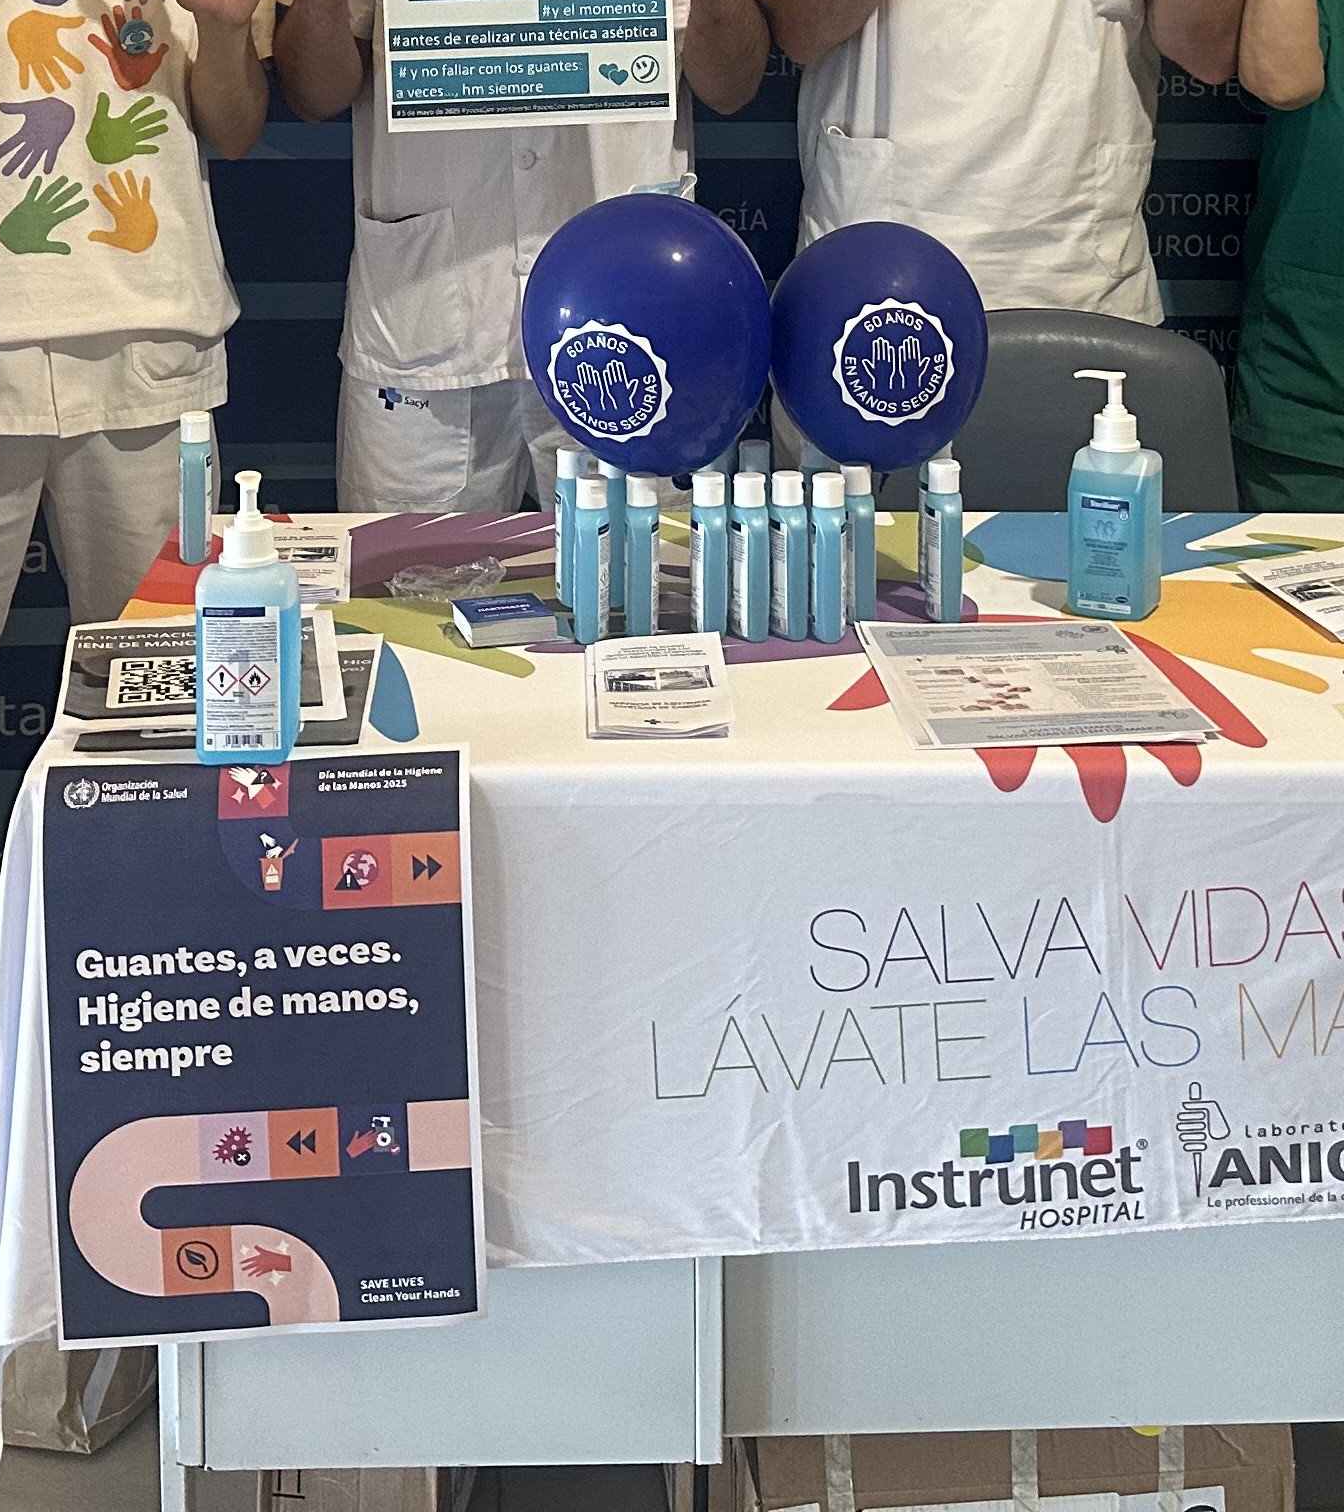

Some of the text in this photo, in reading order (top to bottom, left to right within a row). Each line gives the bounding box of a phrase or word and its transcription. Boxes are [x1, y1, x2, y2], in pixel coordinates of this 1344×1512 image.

[579, 3, 645, 15] momento
[393, 25, 657, 46] #antes realizar una técnica aséptica
[442, 61, 523, 76] fallar con los
[488, 81, 543, 97] siempre
[886, 310, 924, 331] AÑOS
[587, 333, 628, 355] AÑOS
[849, 353, 945, 413] MANOS SEGURAS
[569, 374, 657, 432] MANOS SEGURAS
[337, 765, 442, 779] Mundial Higiene
[102, 779, 158, 793] Organización
[349, 778, 407, 790] Manos 2025
[102, 787, 188, 803] Mundial Salud
[810, 896, 1101, 992] SALVA
[76, 941, 402, 978] Guantes, a veces.
[78, 986, 419, 1032] Higiene de manos,
[651, 994, 991, 1100] LÁVATE
[1024, 985, 1201, 1076] LAS
[80, 1039, 233, 1077] siempre
[1225, 1191, 1306, 1209] professionnel
[1019, 1200, 1146, 1231] HOSPITAL
[360, 1276, 424, 1290] SAVE LIVES
[361, 1288, 460, 1303] Clean Your Hands
